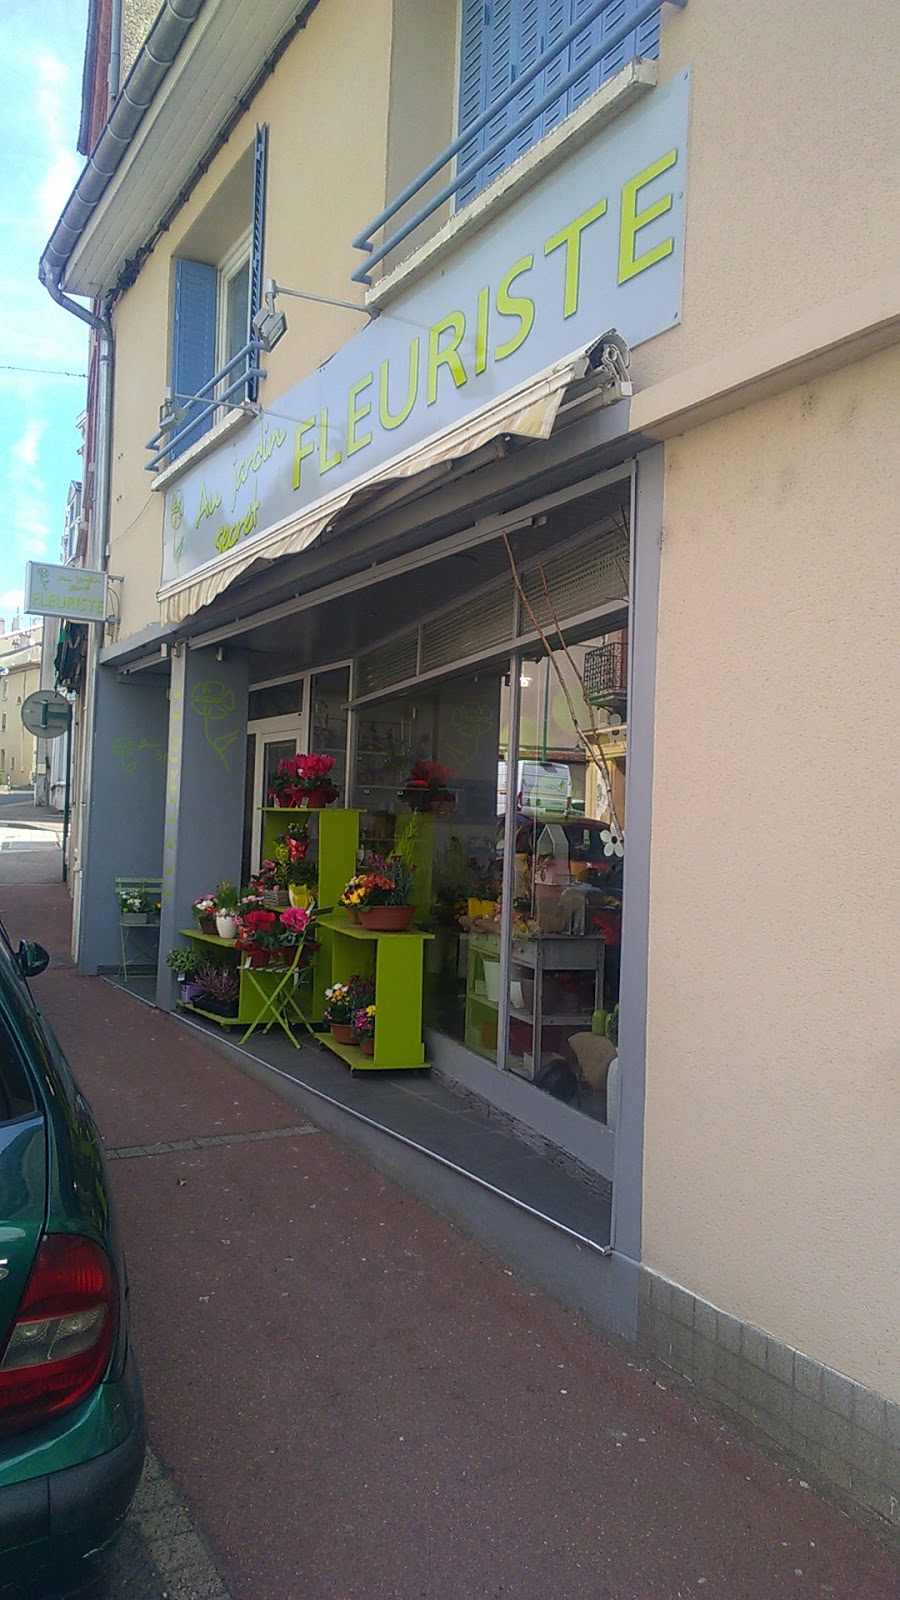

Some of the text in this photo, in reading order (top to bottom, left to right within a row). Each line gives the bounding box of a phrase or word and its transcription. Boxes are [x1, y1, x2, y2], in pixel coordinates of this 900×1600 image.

[292, 148, 677, 491] FLEURISTE
[196, 418, 286, 529] Au jardin
[215, 478, 260, 553] secret
[31, 591, 104, 614] FLEURISTE
